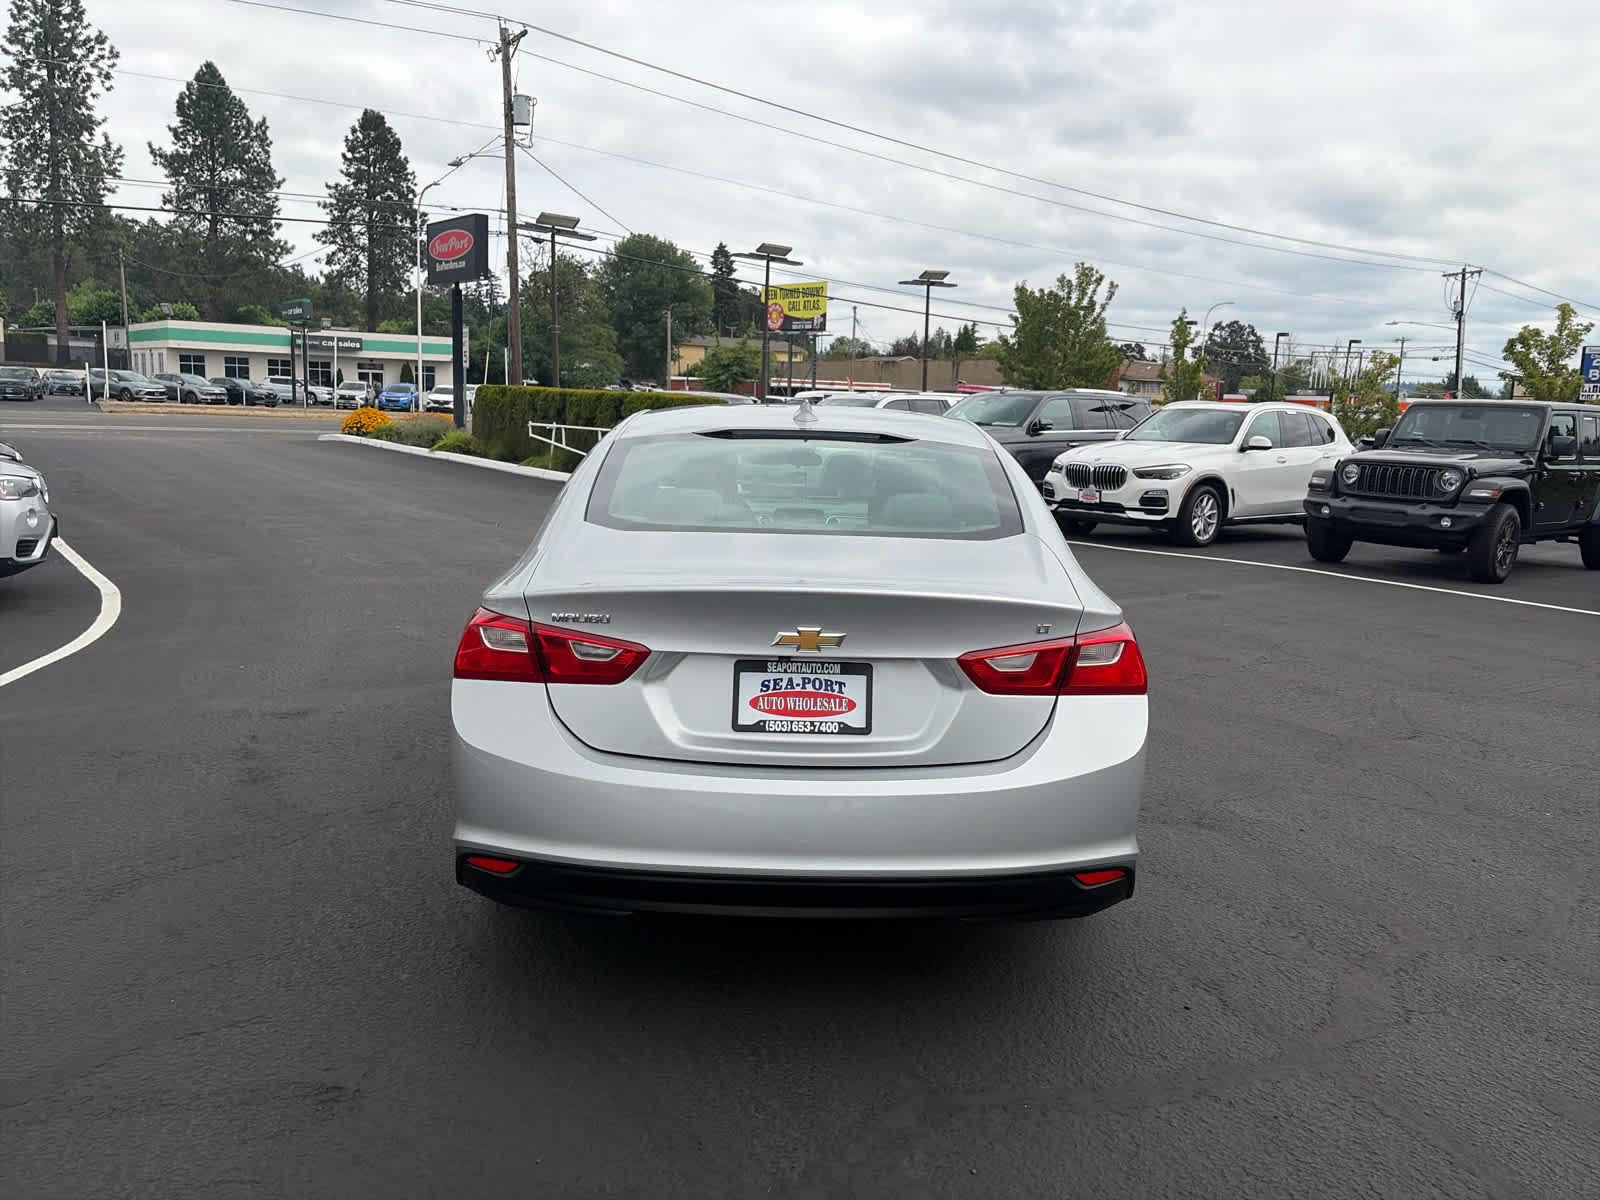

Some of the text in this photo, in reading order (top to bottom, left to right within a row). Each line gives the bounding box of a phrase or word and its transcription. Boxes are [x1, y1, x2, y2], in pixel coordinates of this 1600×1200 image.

[788, 301, 801, 312] CALL
[338, 340, 361, 349] sales
[551, 612, 612, 625] MALIBU
[767, 662, 841, 674] SEAPORTAUTO.COM
[760, 676, 846, 694] SEA-PORT
[757, 696, 849, 712] AUTO WHOLESALE
